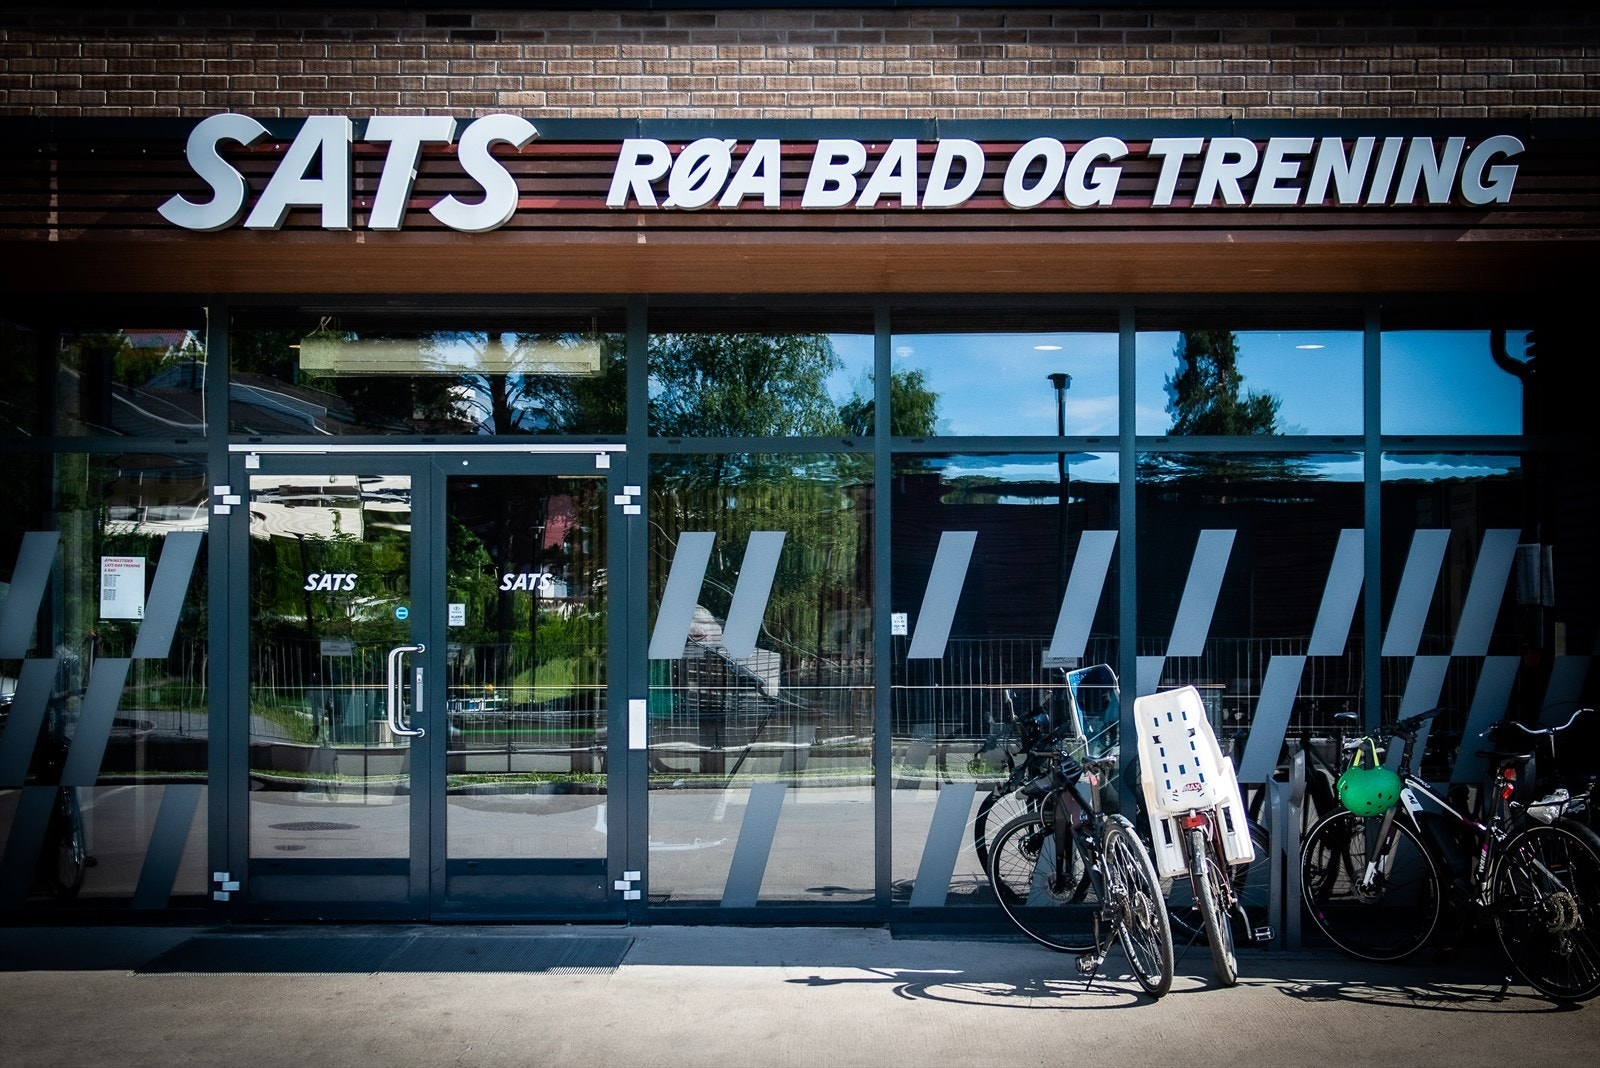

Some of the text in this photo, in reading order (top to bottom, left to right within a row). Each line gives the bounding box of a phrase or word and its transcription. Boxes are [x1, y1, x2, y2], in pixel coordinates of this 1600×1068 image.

[157, 113, 540, 232] SATS
[605, 134, 1525, 211] RØA BAD OG TRENING
[304, 573, 358, 591] SATS
[499, 573, 553, 591] SATS
